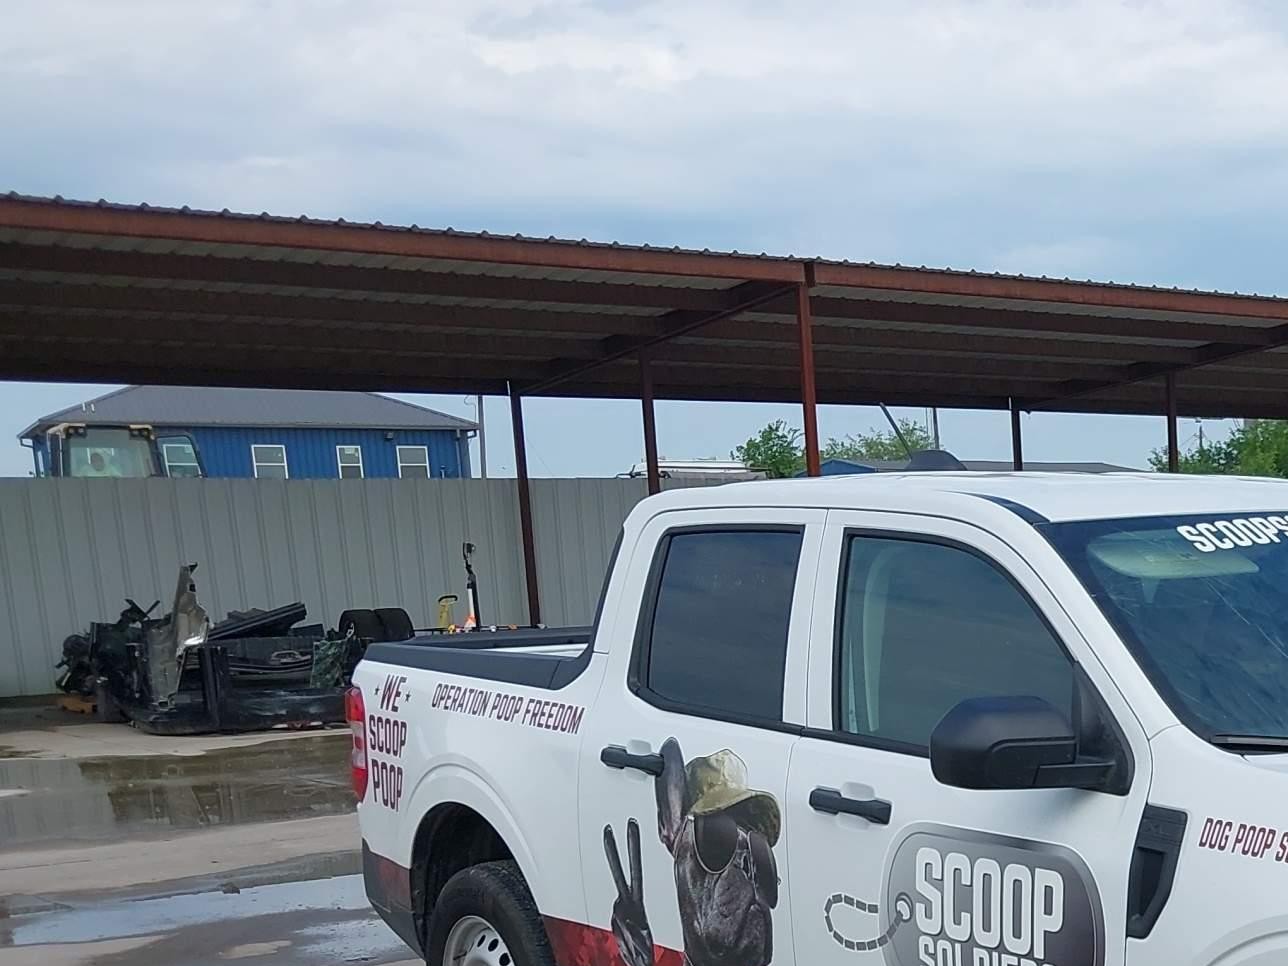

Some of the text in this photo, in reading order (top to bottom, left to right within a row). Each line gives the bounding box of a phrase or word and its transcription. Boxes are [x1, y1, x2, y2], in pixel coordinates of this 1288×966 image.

[380, 674, 407, 713] WE
[431, 683, 586, 735] OPERATION POOP FREEDOM
[369, 714, 407, 758] SCOOP
[371, 759, 404, 813] POOP
[1199, 817, 1233, 851] DOG
[1231, 823, 1276, 859] POOP
[915, 846, 1065, 960] SCOOP
